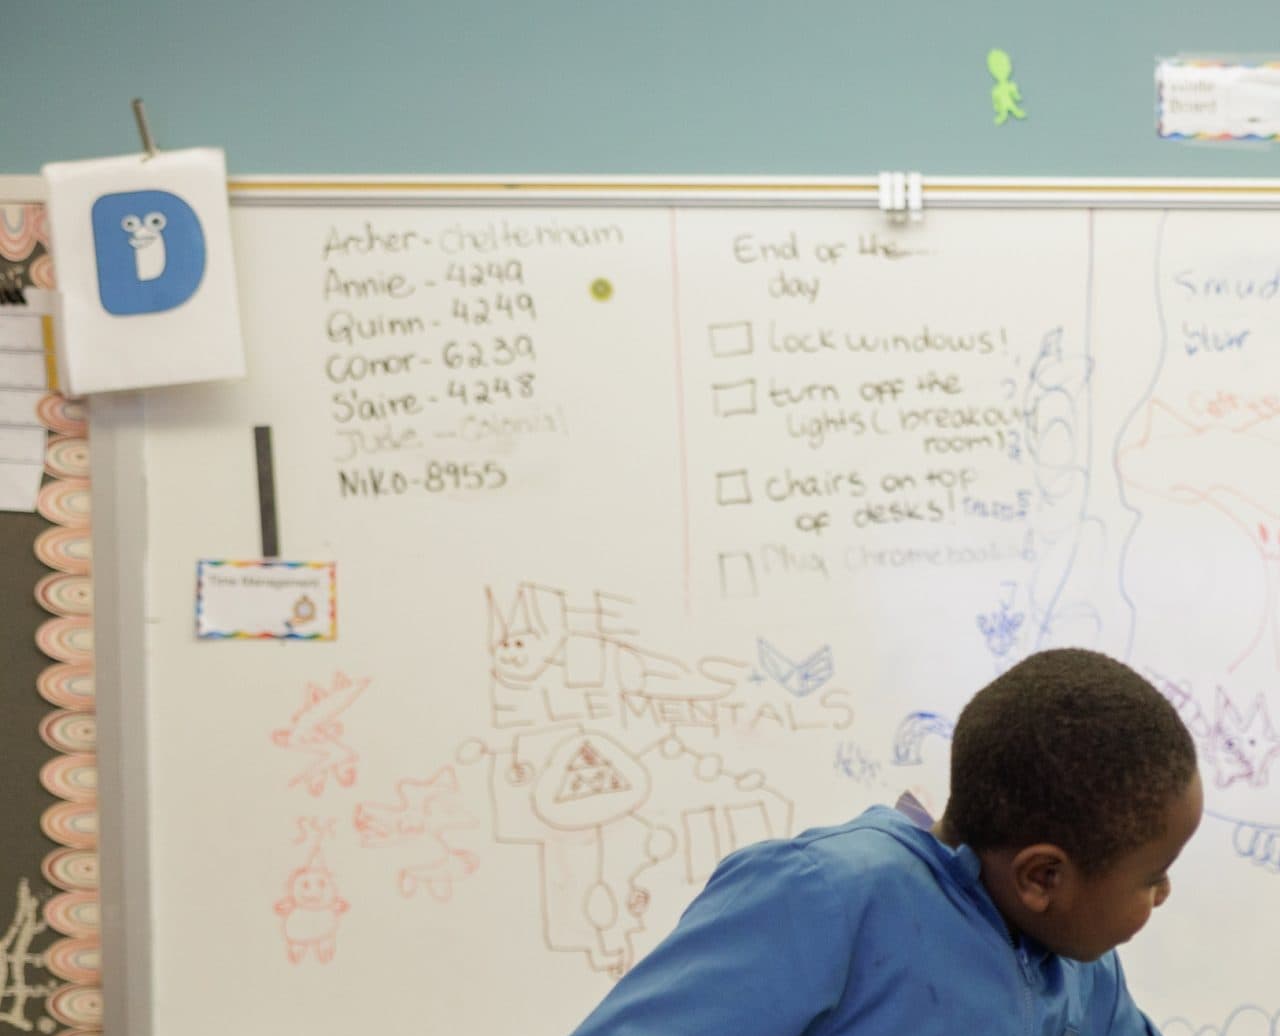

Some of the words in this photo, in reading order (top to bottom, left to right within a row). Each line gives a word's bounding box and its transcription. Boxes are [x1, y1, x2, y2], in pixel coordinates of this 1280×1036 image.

[733, 231, 800, 264] End
[814, 241, 846, 263] of
[324, 267, 416, 300] Annie
[445, 259, 525, 288] 4249
[768, 272, 821, 303] day
[451, 292, 537, 325] 4249
[441, 334, 536, 369] 6239
[767, 319, 836, 354] lock
[844, 325, 1007, 354] windows!
[446, 371, 536, 405] 4248
[768, 376, 839, 407] turn
[858, 378, 904, 402] off
[915, 371, 963, 395] the
[765, 468, 866, 502] chairs
[881, 475, 916, 493] on
[924, 466, 977, 490] top
[795, 511, 830, 535] of
